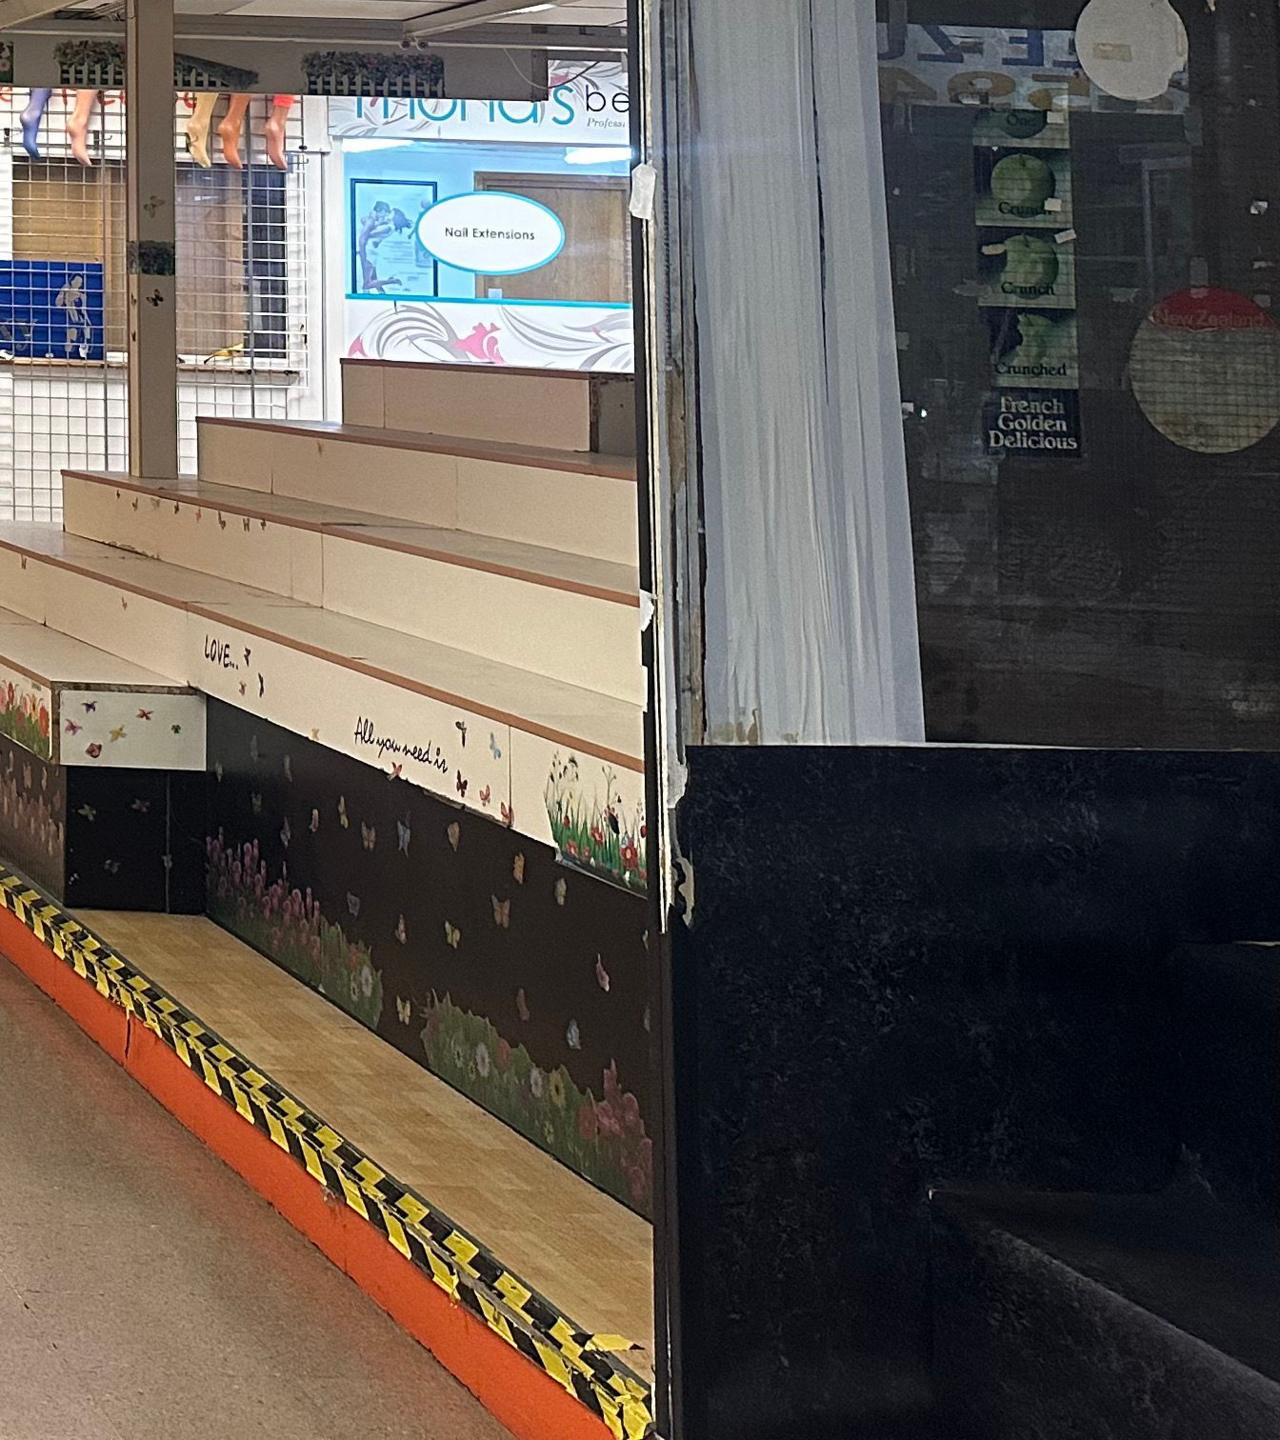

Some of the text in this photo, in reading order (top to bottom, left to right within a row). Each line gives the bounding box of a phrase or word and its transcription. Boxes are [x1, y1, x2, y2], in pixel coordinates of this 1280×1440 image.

[585, 84, 630, 113] be
[445, 226, 536, 241] Nail Extensions
[1000, 280, 1056, 296] Crunch
[1196, 309, 1265, 327] Zealand
[994, 361, 1068, 376] Crunched
[1000, 396, 1065, 414] French
[997, 413, 1068, 431] Golden
[988, 430, 1078, 449] Delicious
[353, 715, 375, 745] All
[375, 736, 401, 759] you
[401, 740, 433, 764] need
